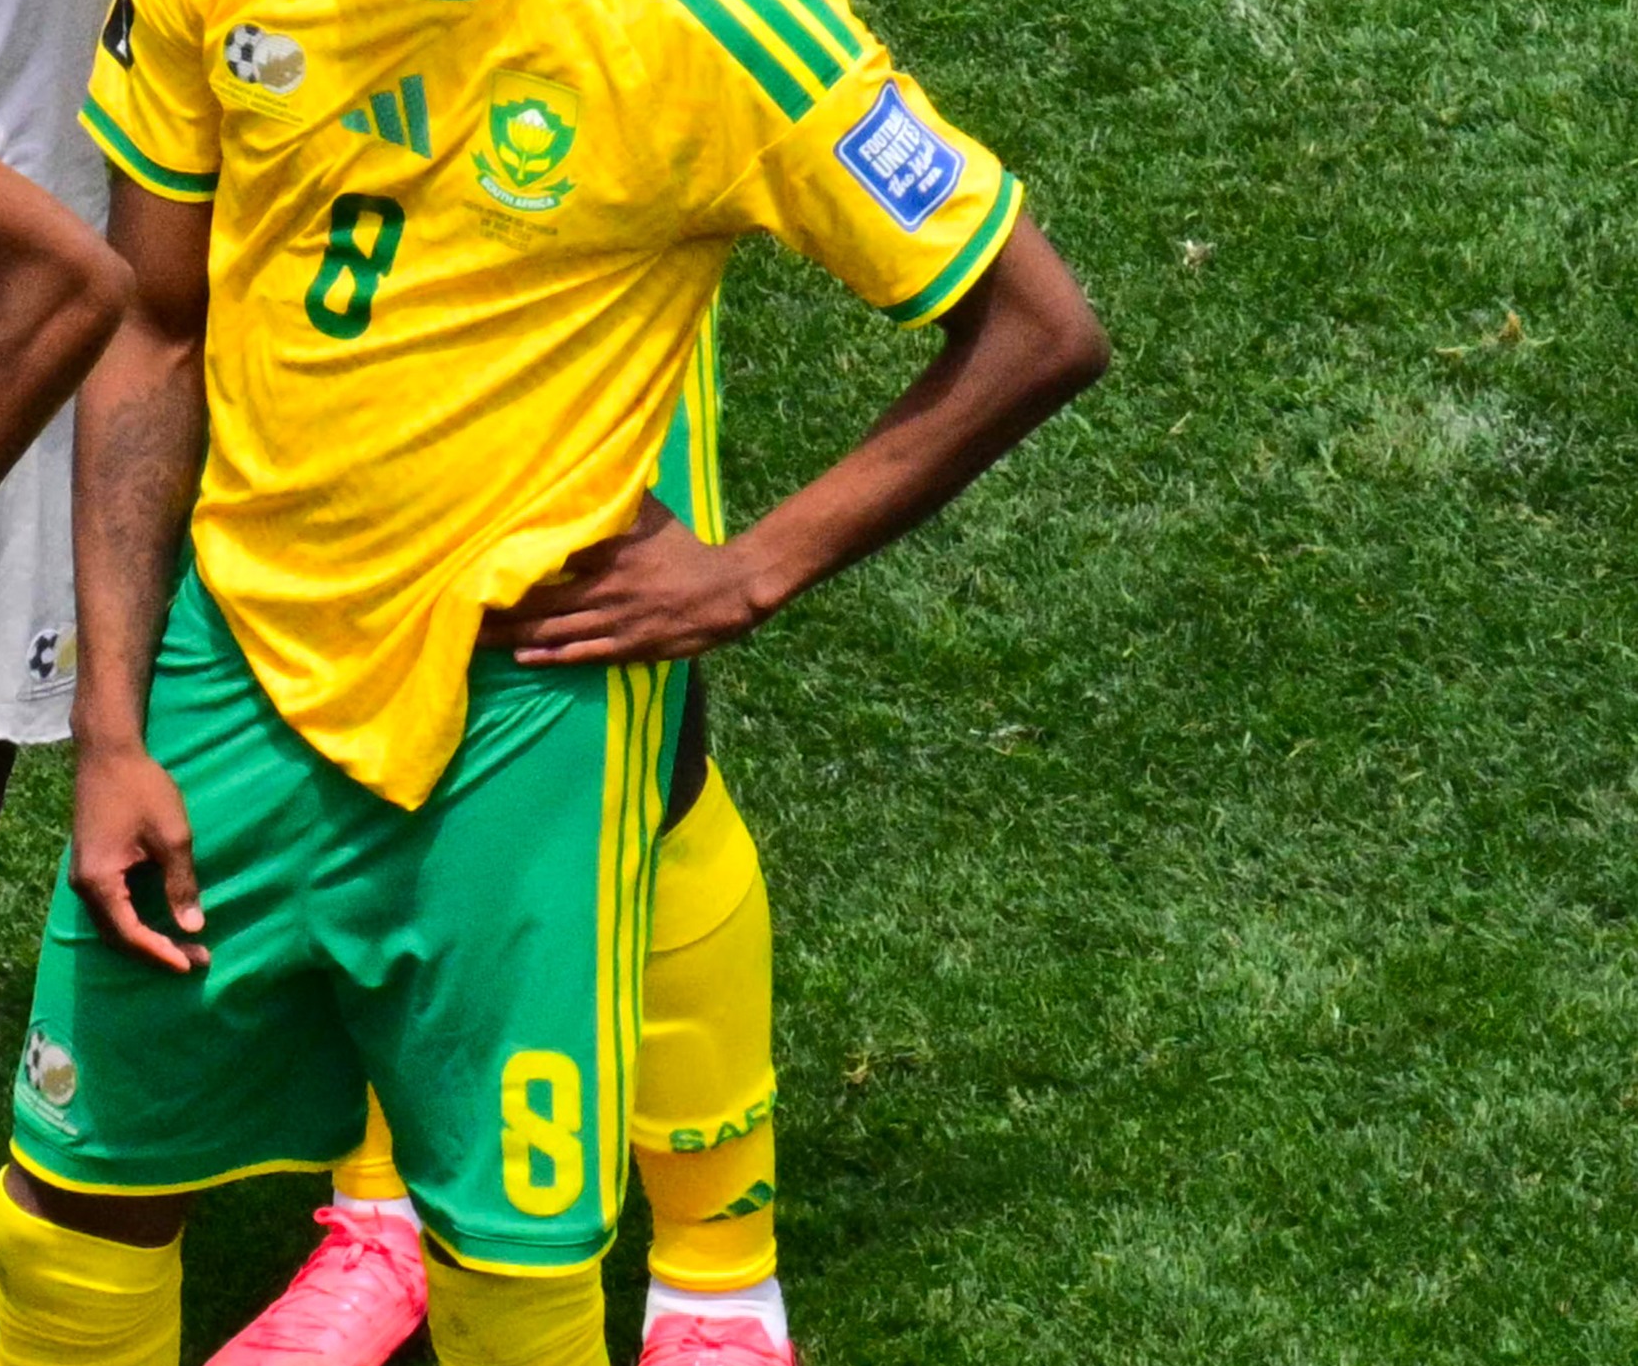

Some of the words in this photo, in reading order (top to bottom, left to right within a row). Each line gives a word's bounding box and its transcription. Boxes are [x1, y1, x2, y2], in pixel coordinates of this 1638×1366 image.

[871, 117, 921, 179] UNITES
[888, 174, 915, 198] the
[917, 167, 943, 193] FIFA
[304, 192, 406, 340] 8
[501, 1049, 584, 1218] 8
